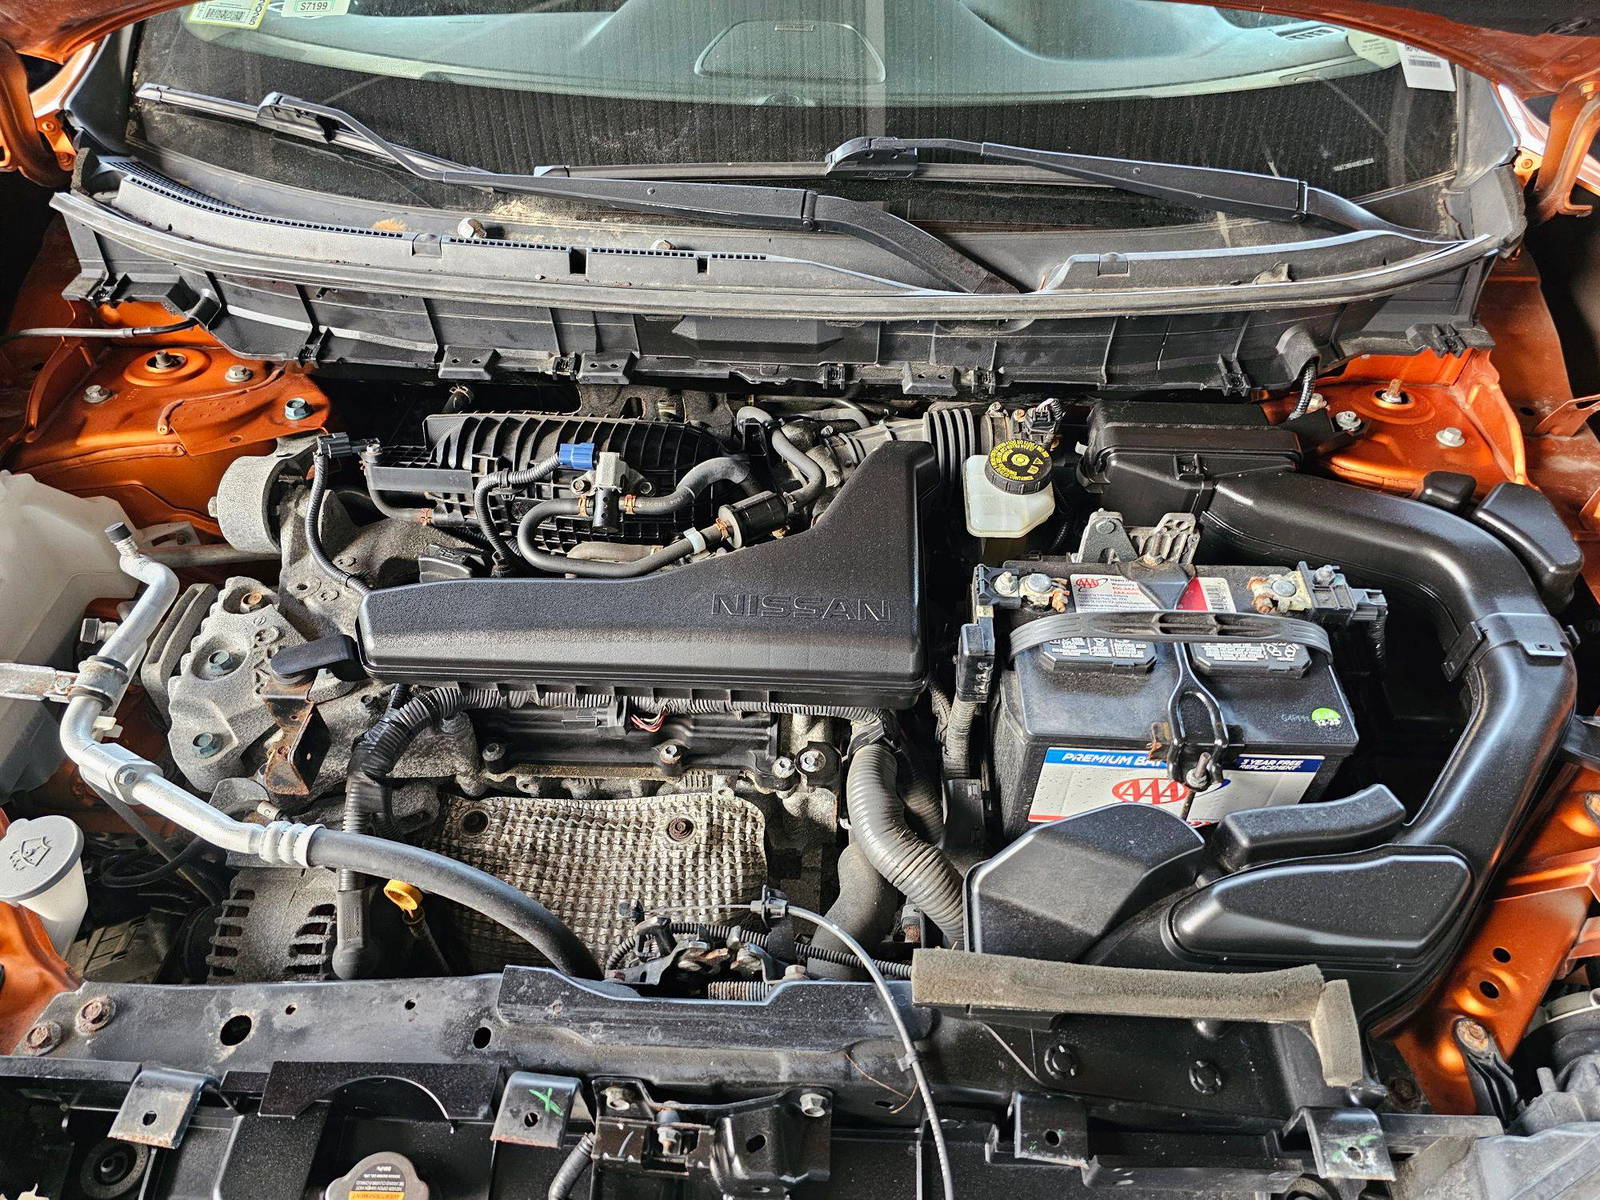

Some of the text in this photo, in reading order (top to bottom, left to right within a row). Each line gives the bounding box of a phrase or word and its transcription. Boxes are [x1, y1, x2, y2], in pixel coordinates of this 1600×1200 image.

[300, 2, 328, 11] S7199
[1077, 577, 1098, 588] AAA
[712, 594, 891, 622] NISSAN
[1062, 753, 1133, 766] PREMIUM
[1121, 777, 1180, 804] AAA
